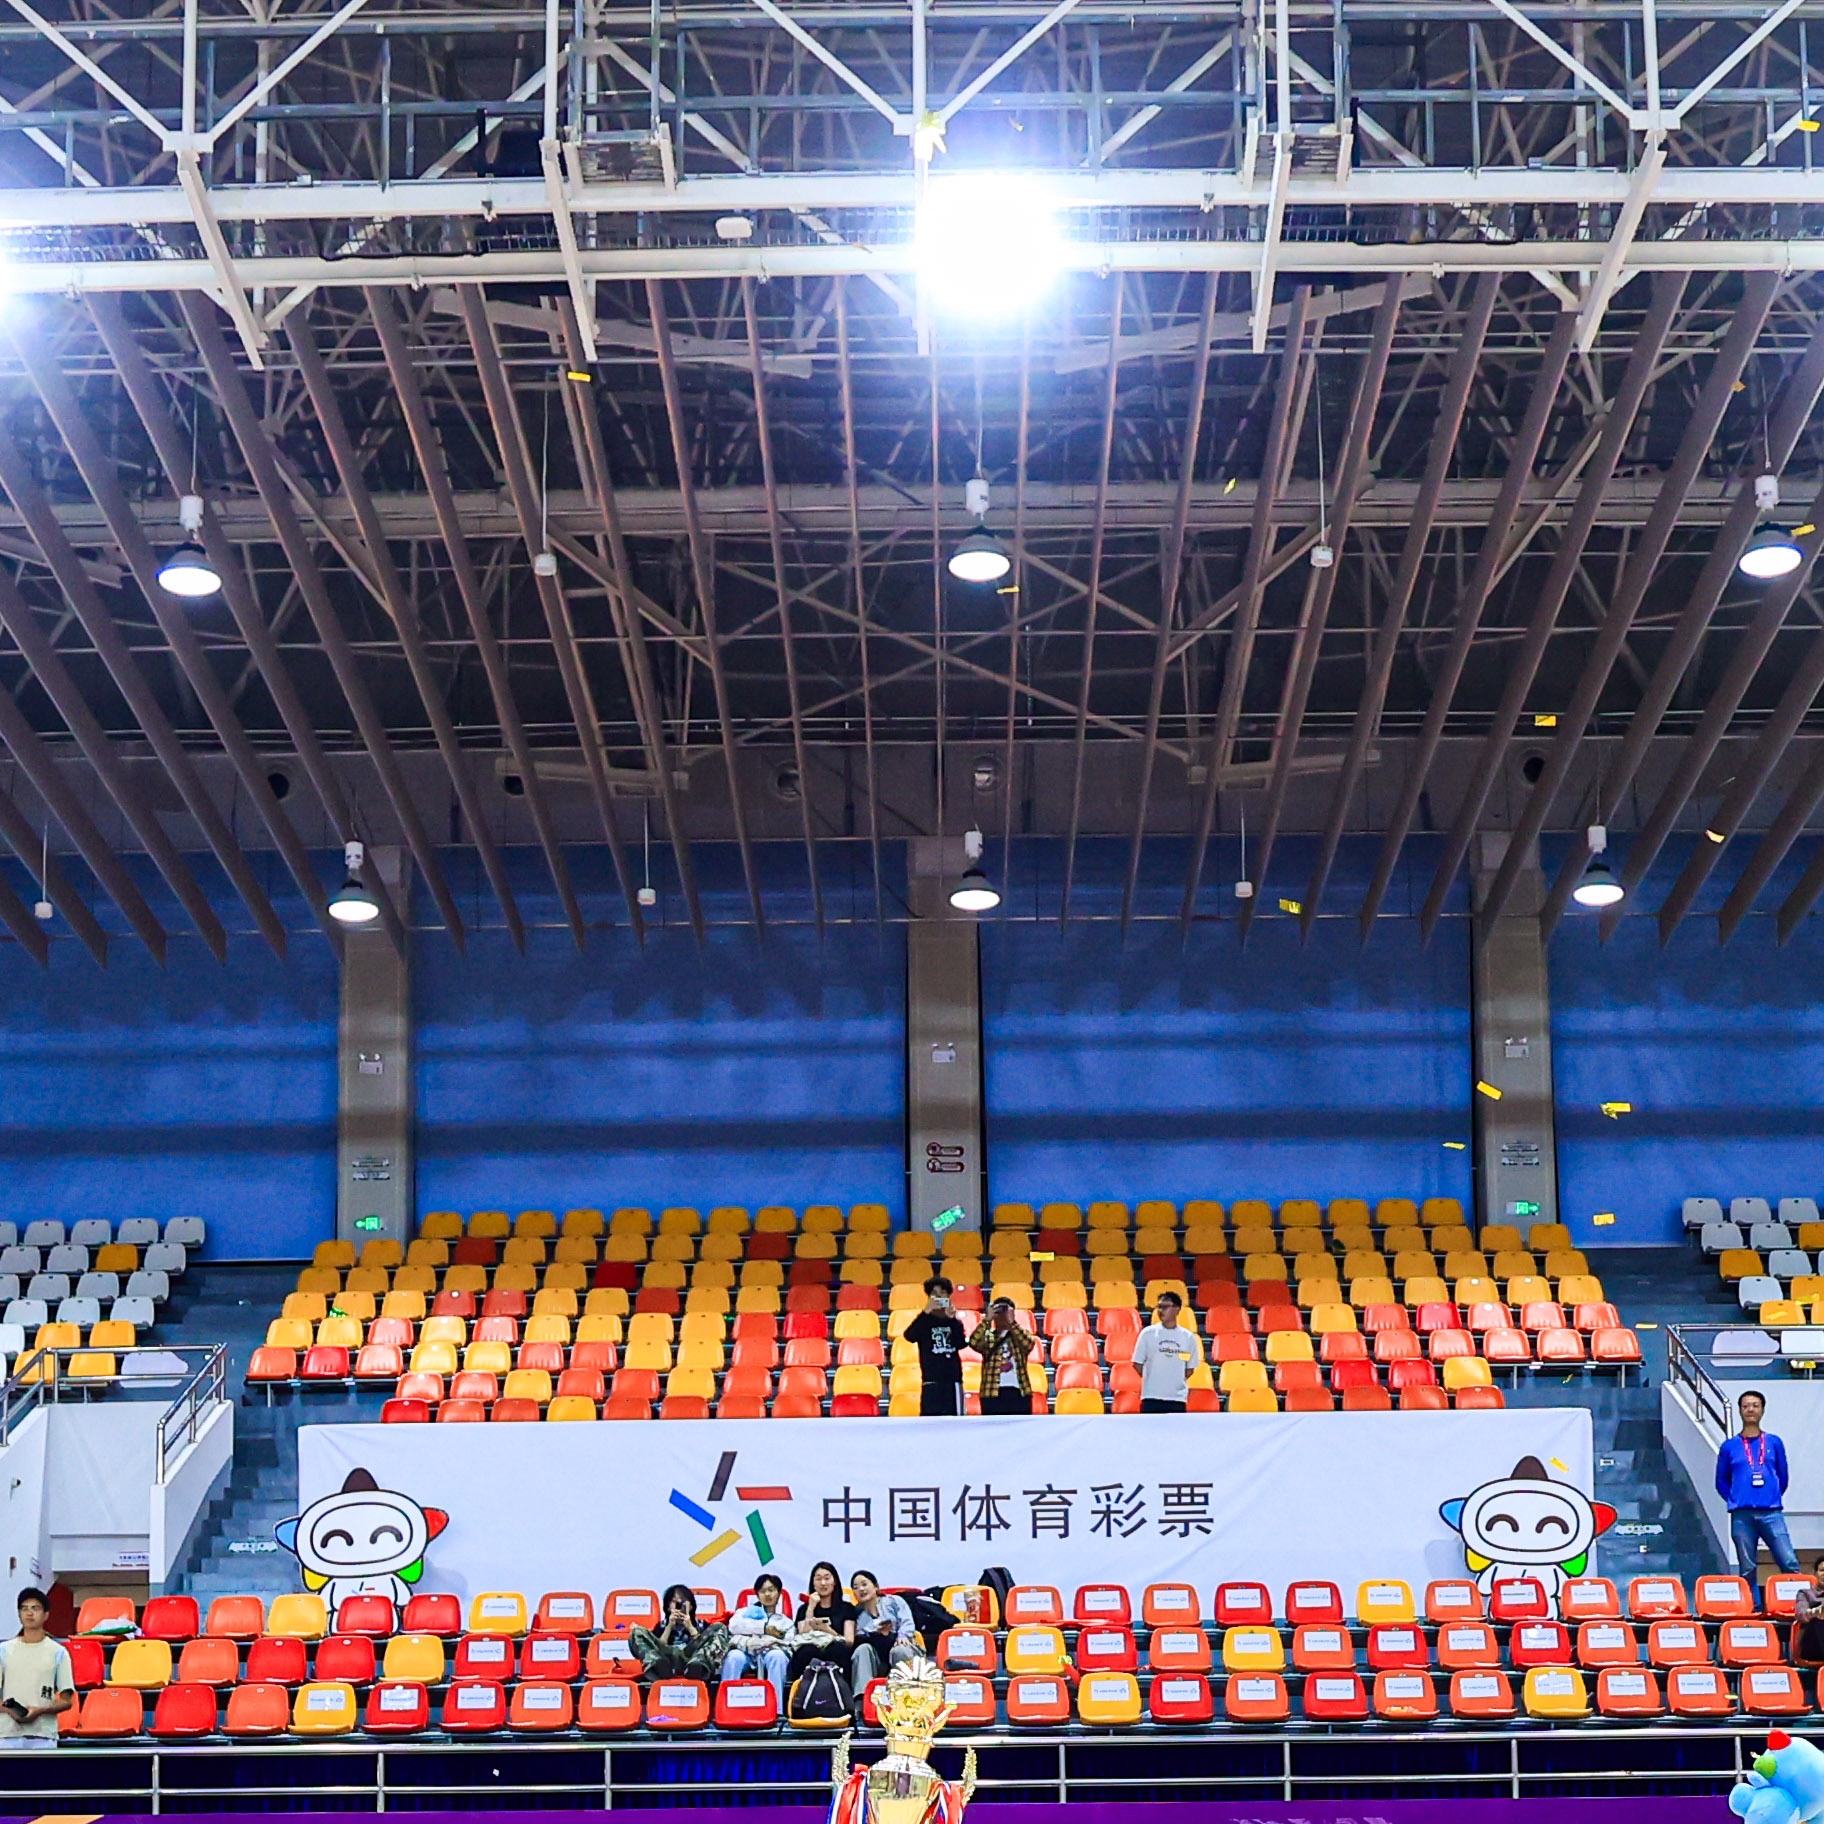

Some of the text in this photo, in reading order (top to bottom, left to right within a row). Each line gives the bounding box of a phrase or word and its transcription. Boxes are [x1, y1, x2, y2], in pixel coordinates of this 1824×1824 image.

[821, 1480, 1216, 1542] 中国体育彩票
